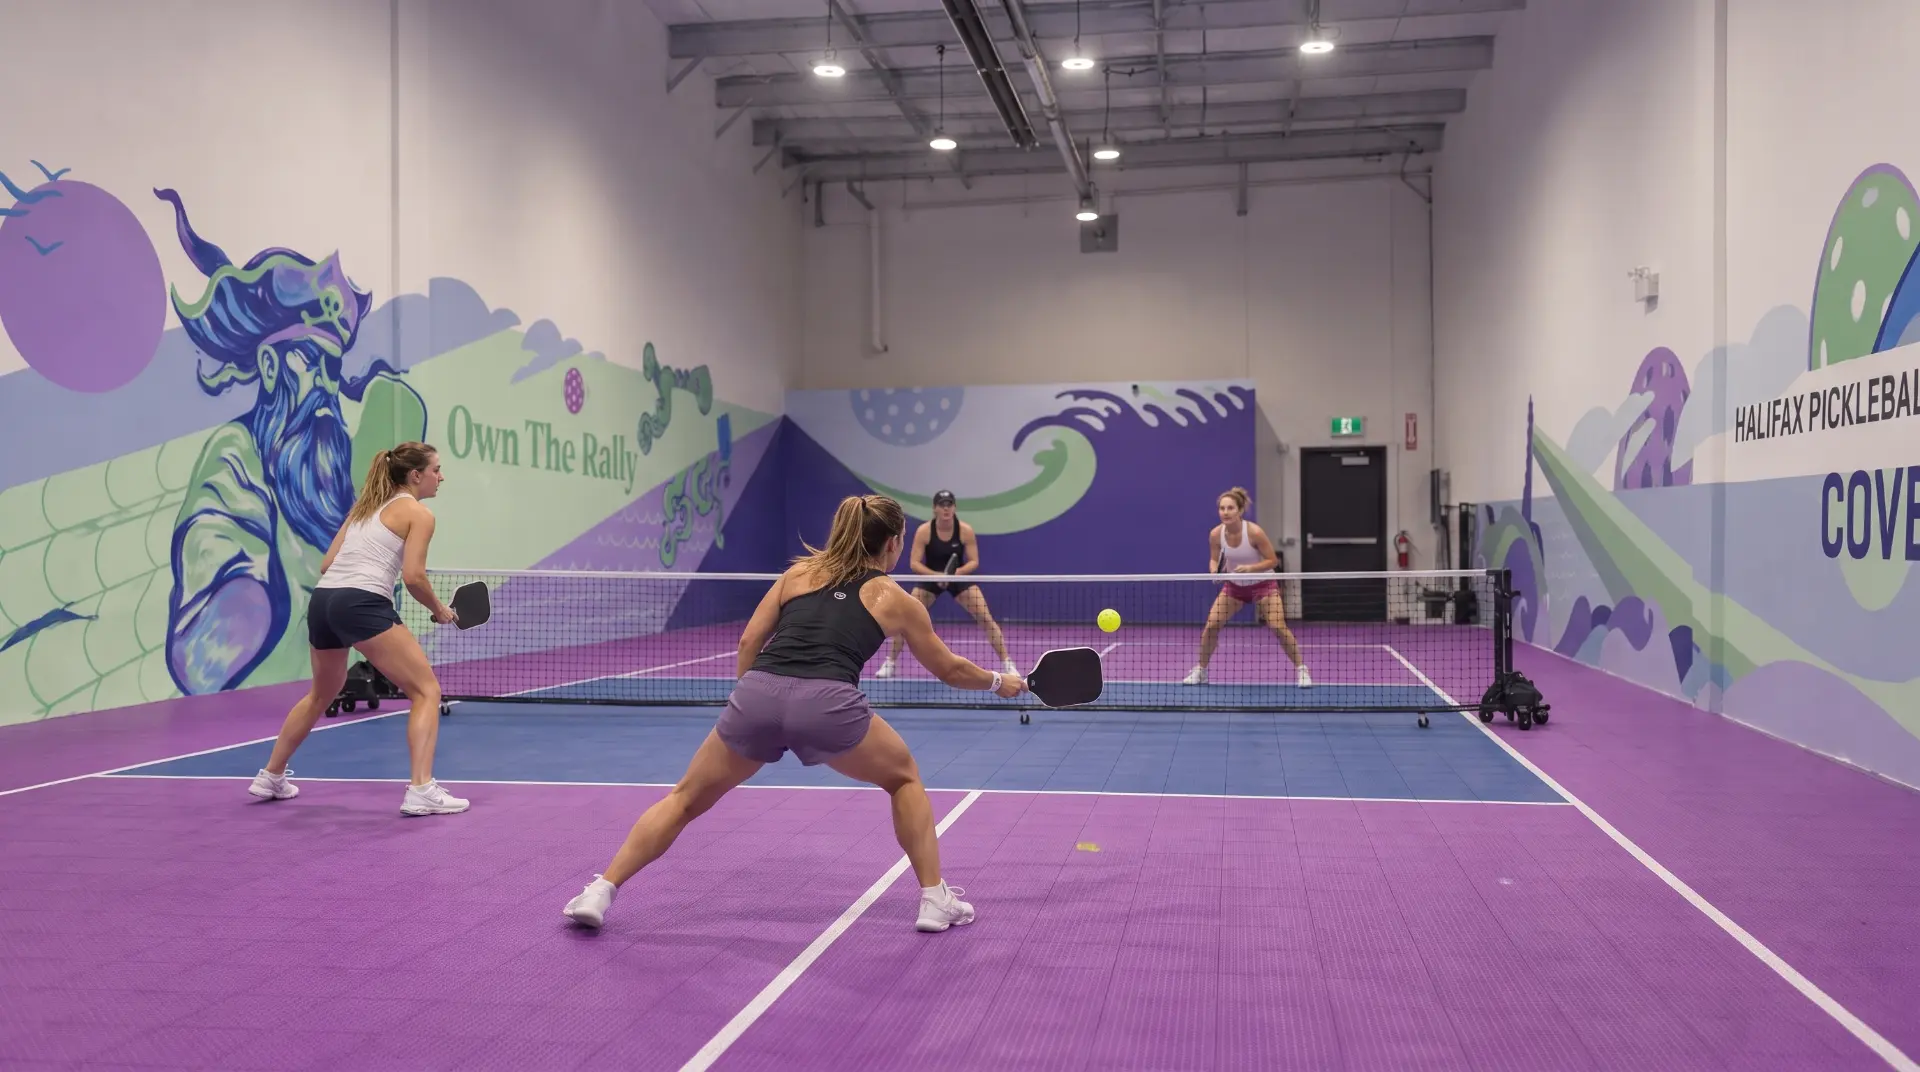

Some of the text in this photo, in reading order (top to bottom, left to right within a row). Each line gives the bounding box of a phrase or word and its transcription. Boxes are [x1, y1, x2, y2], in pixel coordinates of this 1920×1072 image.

[447, 405, 638, 495] Own The Rally
[1735, 368, 1920, 443] HALIFAX PICKLEBAL
[1821, 465, 1920, 561] COVE
